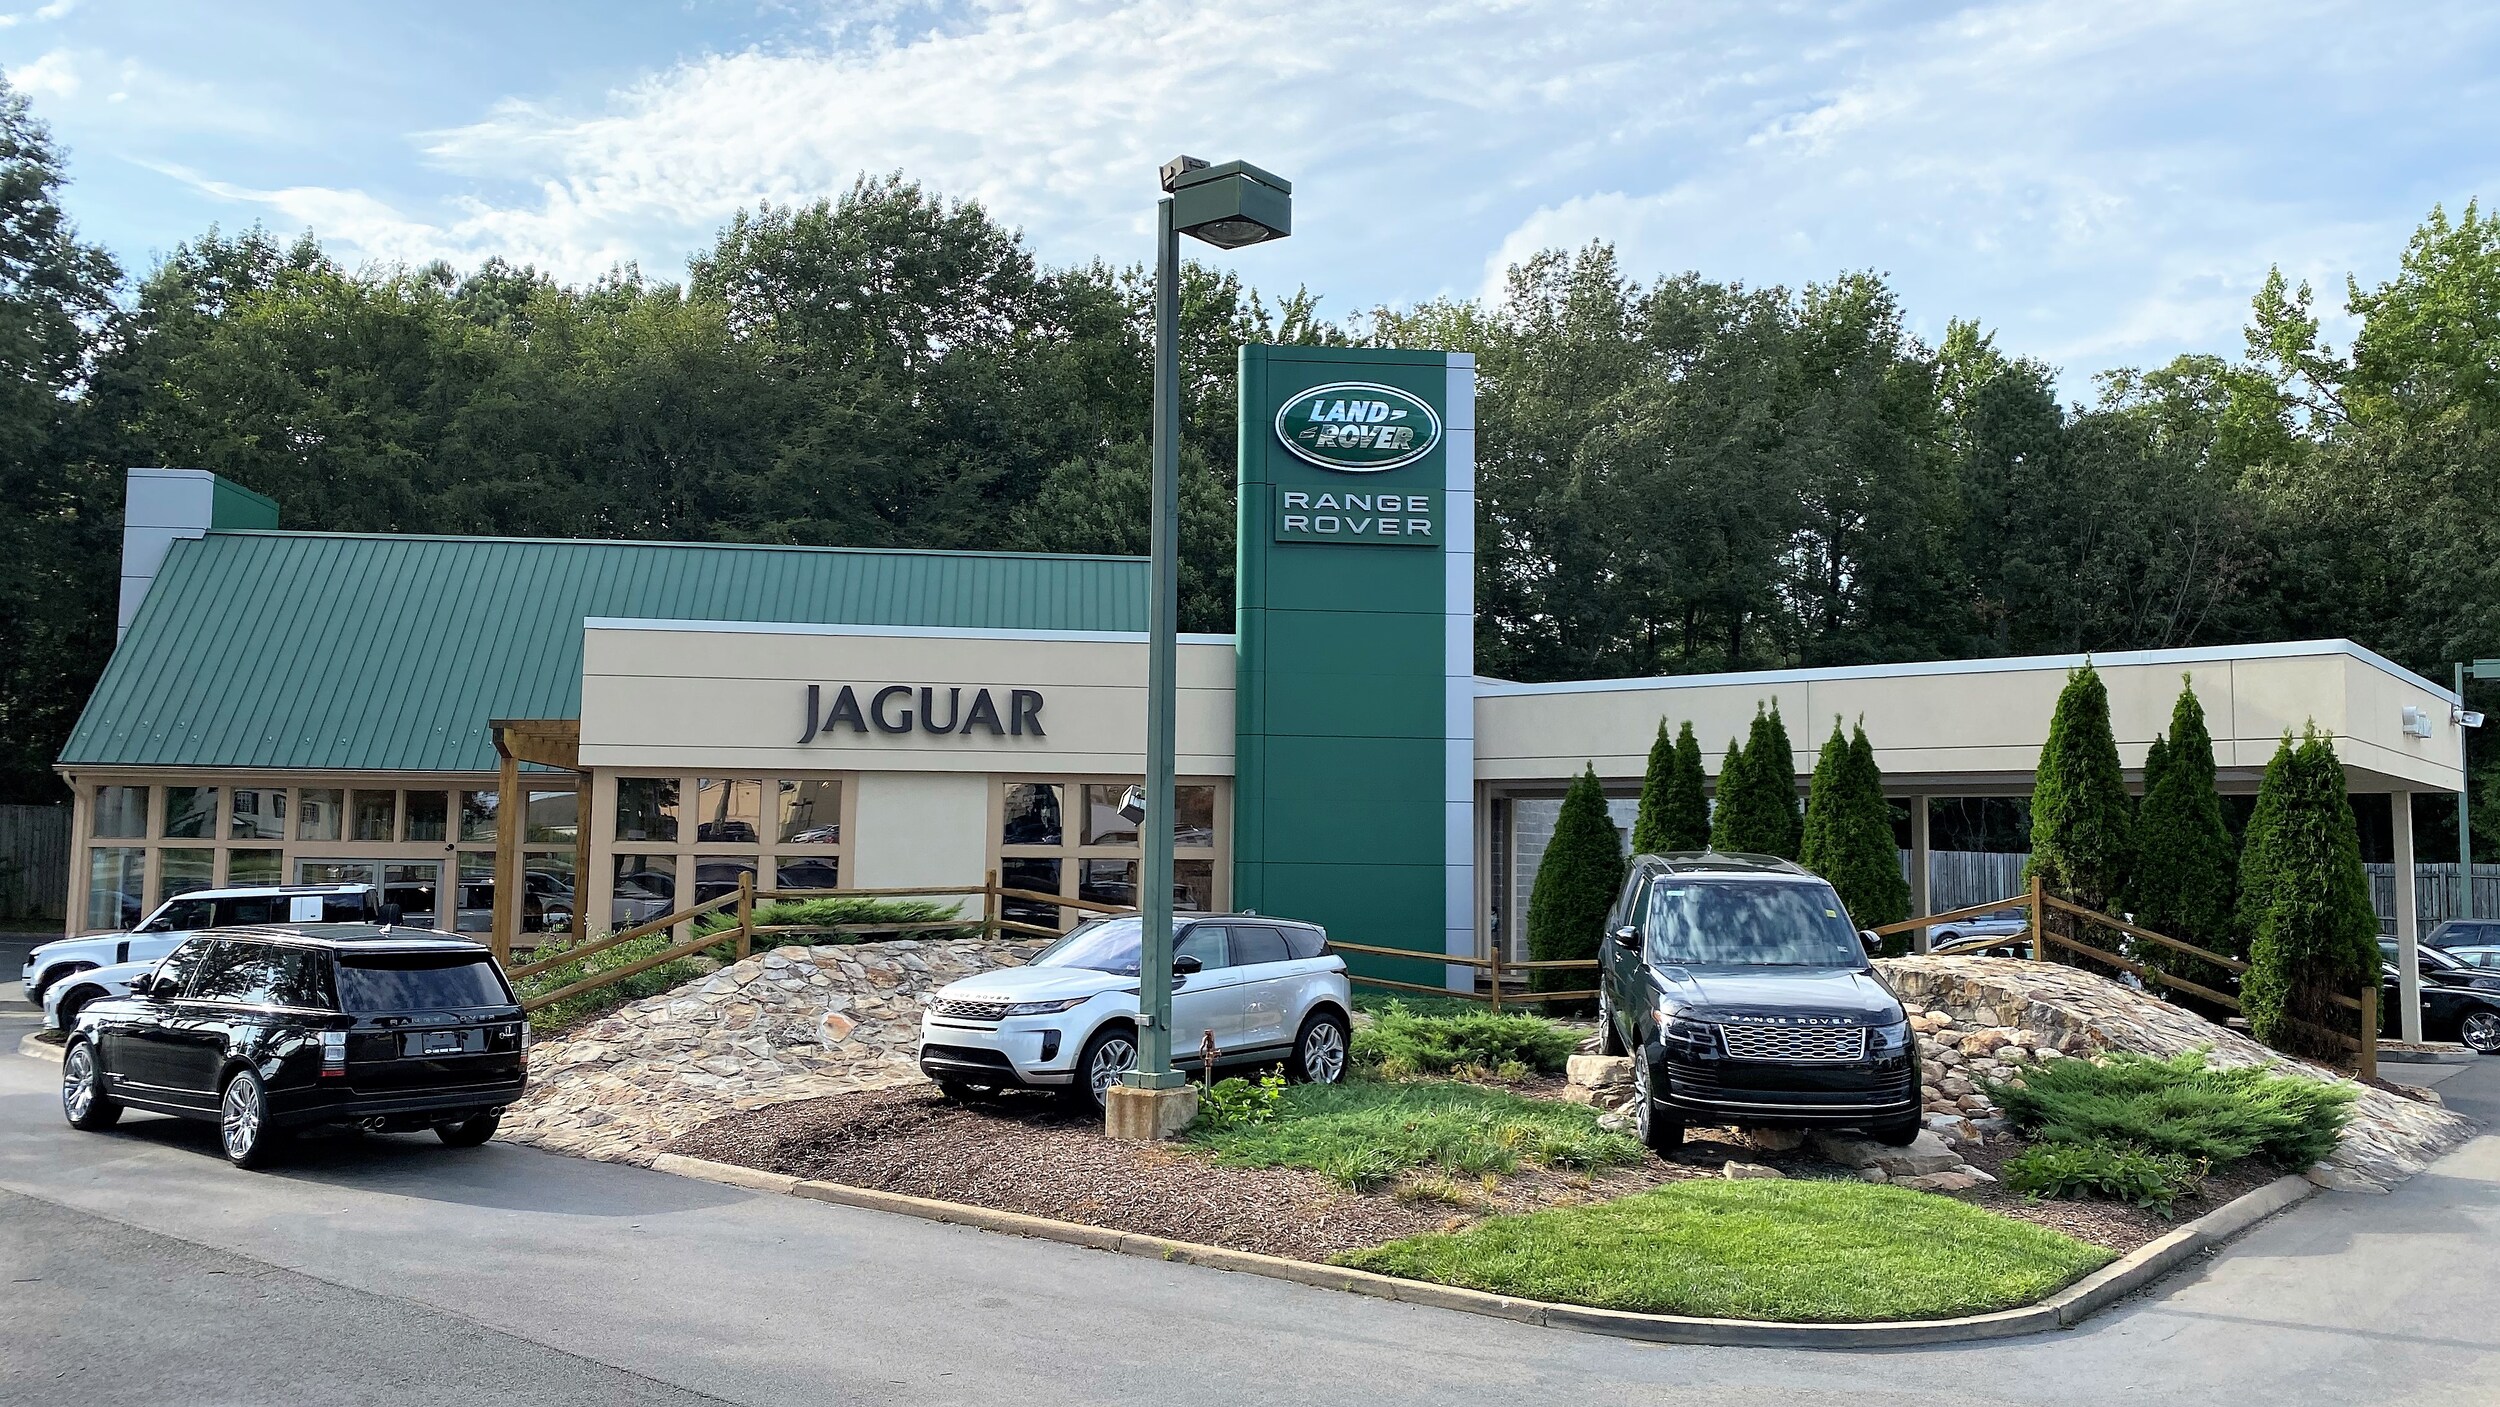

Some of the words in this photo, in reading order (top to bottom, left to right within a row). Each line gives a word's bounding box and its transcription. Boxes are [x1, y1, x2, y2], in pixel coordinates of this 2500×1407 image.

[1308, 400, 1390, 422] LAND
[1315, 425, 1413, 450] ROVER
[1284, 492, 1429, 512] RANGE
[1283, 515, 1432, 536] ROVER
[797, 684, 1047, 744] JAGUAR
[1730, 1015, 1787, 1024] RANGE
